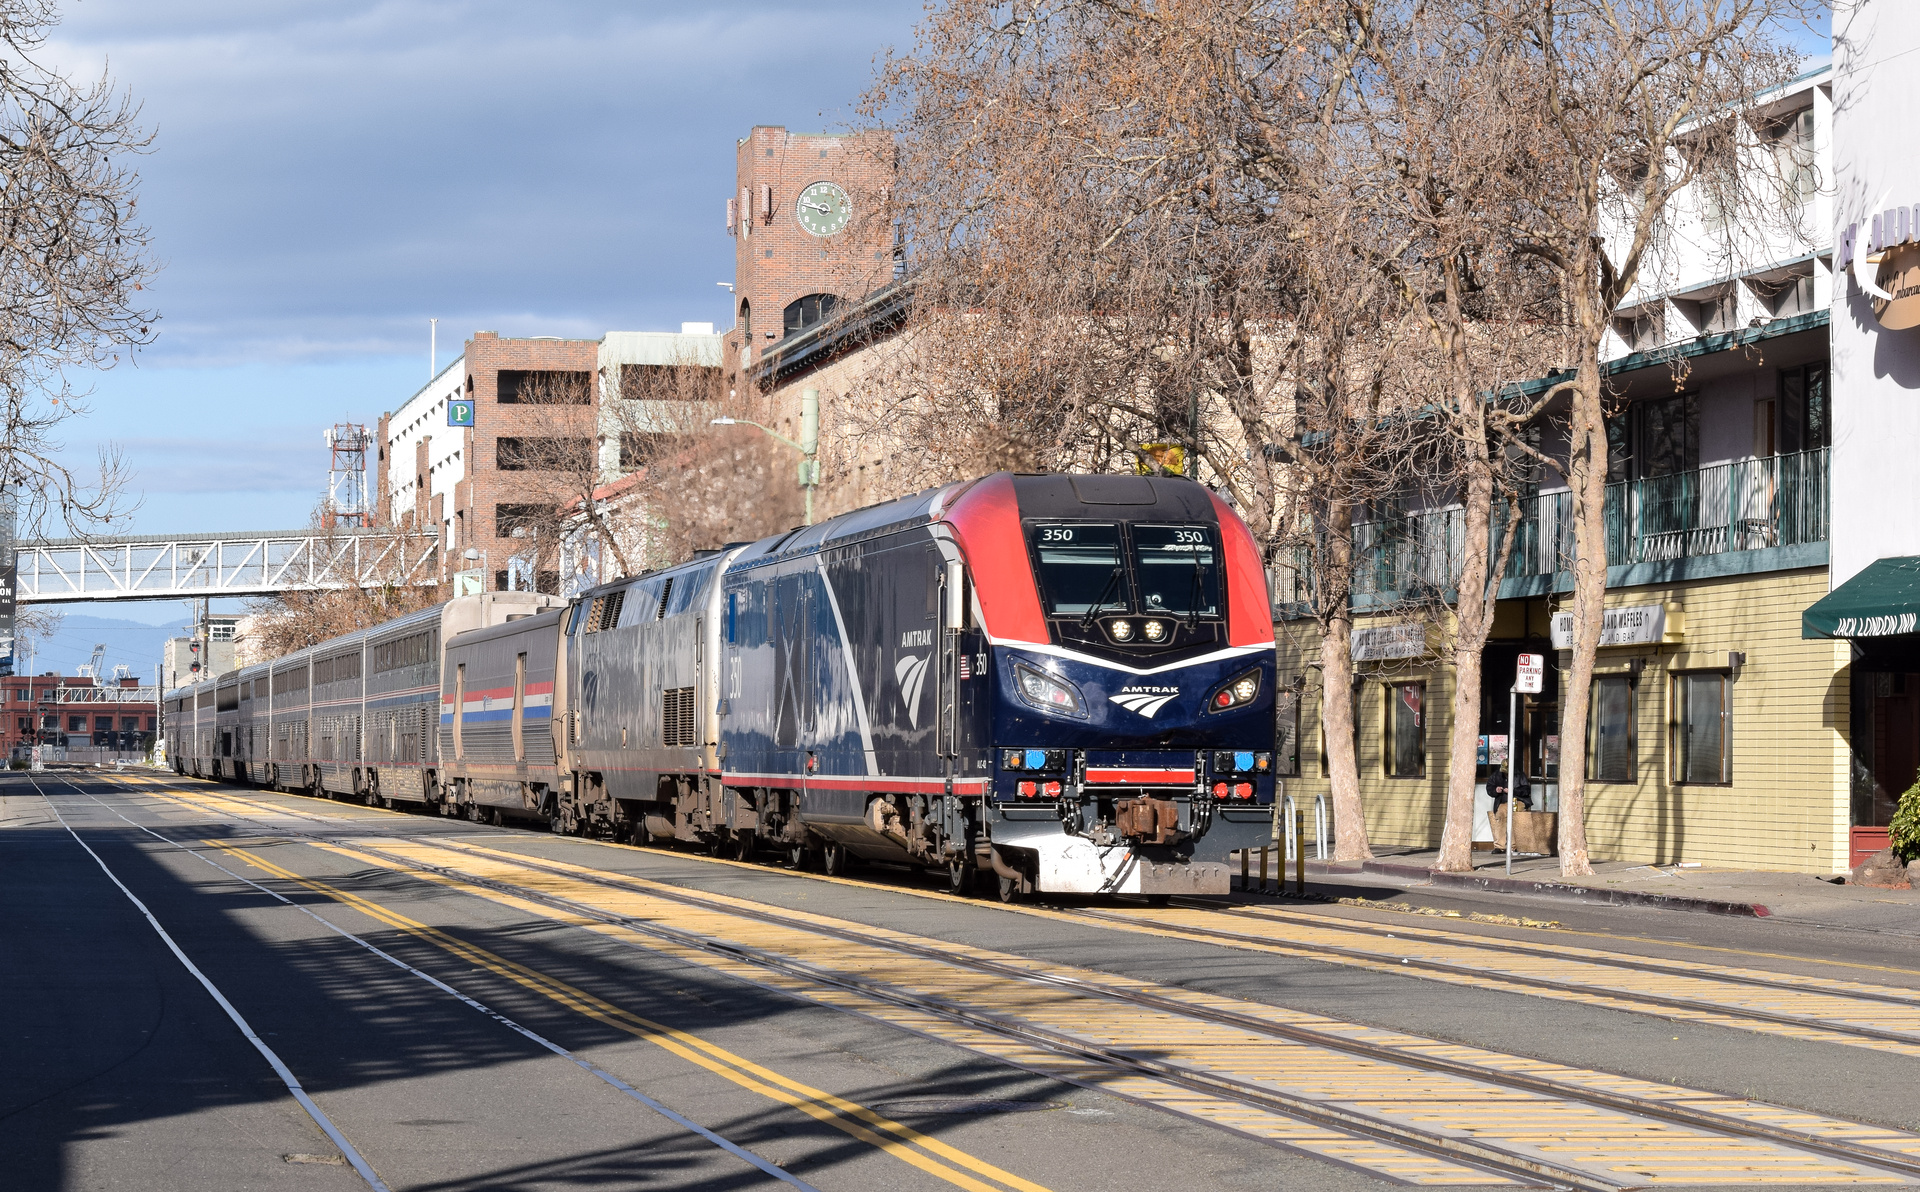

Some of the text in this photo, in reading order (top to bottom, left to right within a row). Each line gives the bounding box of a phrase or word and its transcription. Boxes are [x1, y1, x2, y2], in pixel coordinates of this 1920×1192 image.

[455, 405, 468, 422] P
[1042, 529, 1074, 541] 350
[1174, 530, 1203, 543] 350
[1606, 614, 1618, 630] AND
[1619, 611, 1643, 629] WAFFLES
[1833, 612, 1917, 636] JACK LONDON INN
[902, 629, 932, 648] AMTRAK
[1608, 633, 1619, 642] AND
[1623, 632, 1635, 642] BAR
[976, 653, 987, 676] 350
[1520, 656, 1529, 664] NO
[730, 656, 742, 698] 350
[1520, 667, 1542, 675] PARKING
